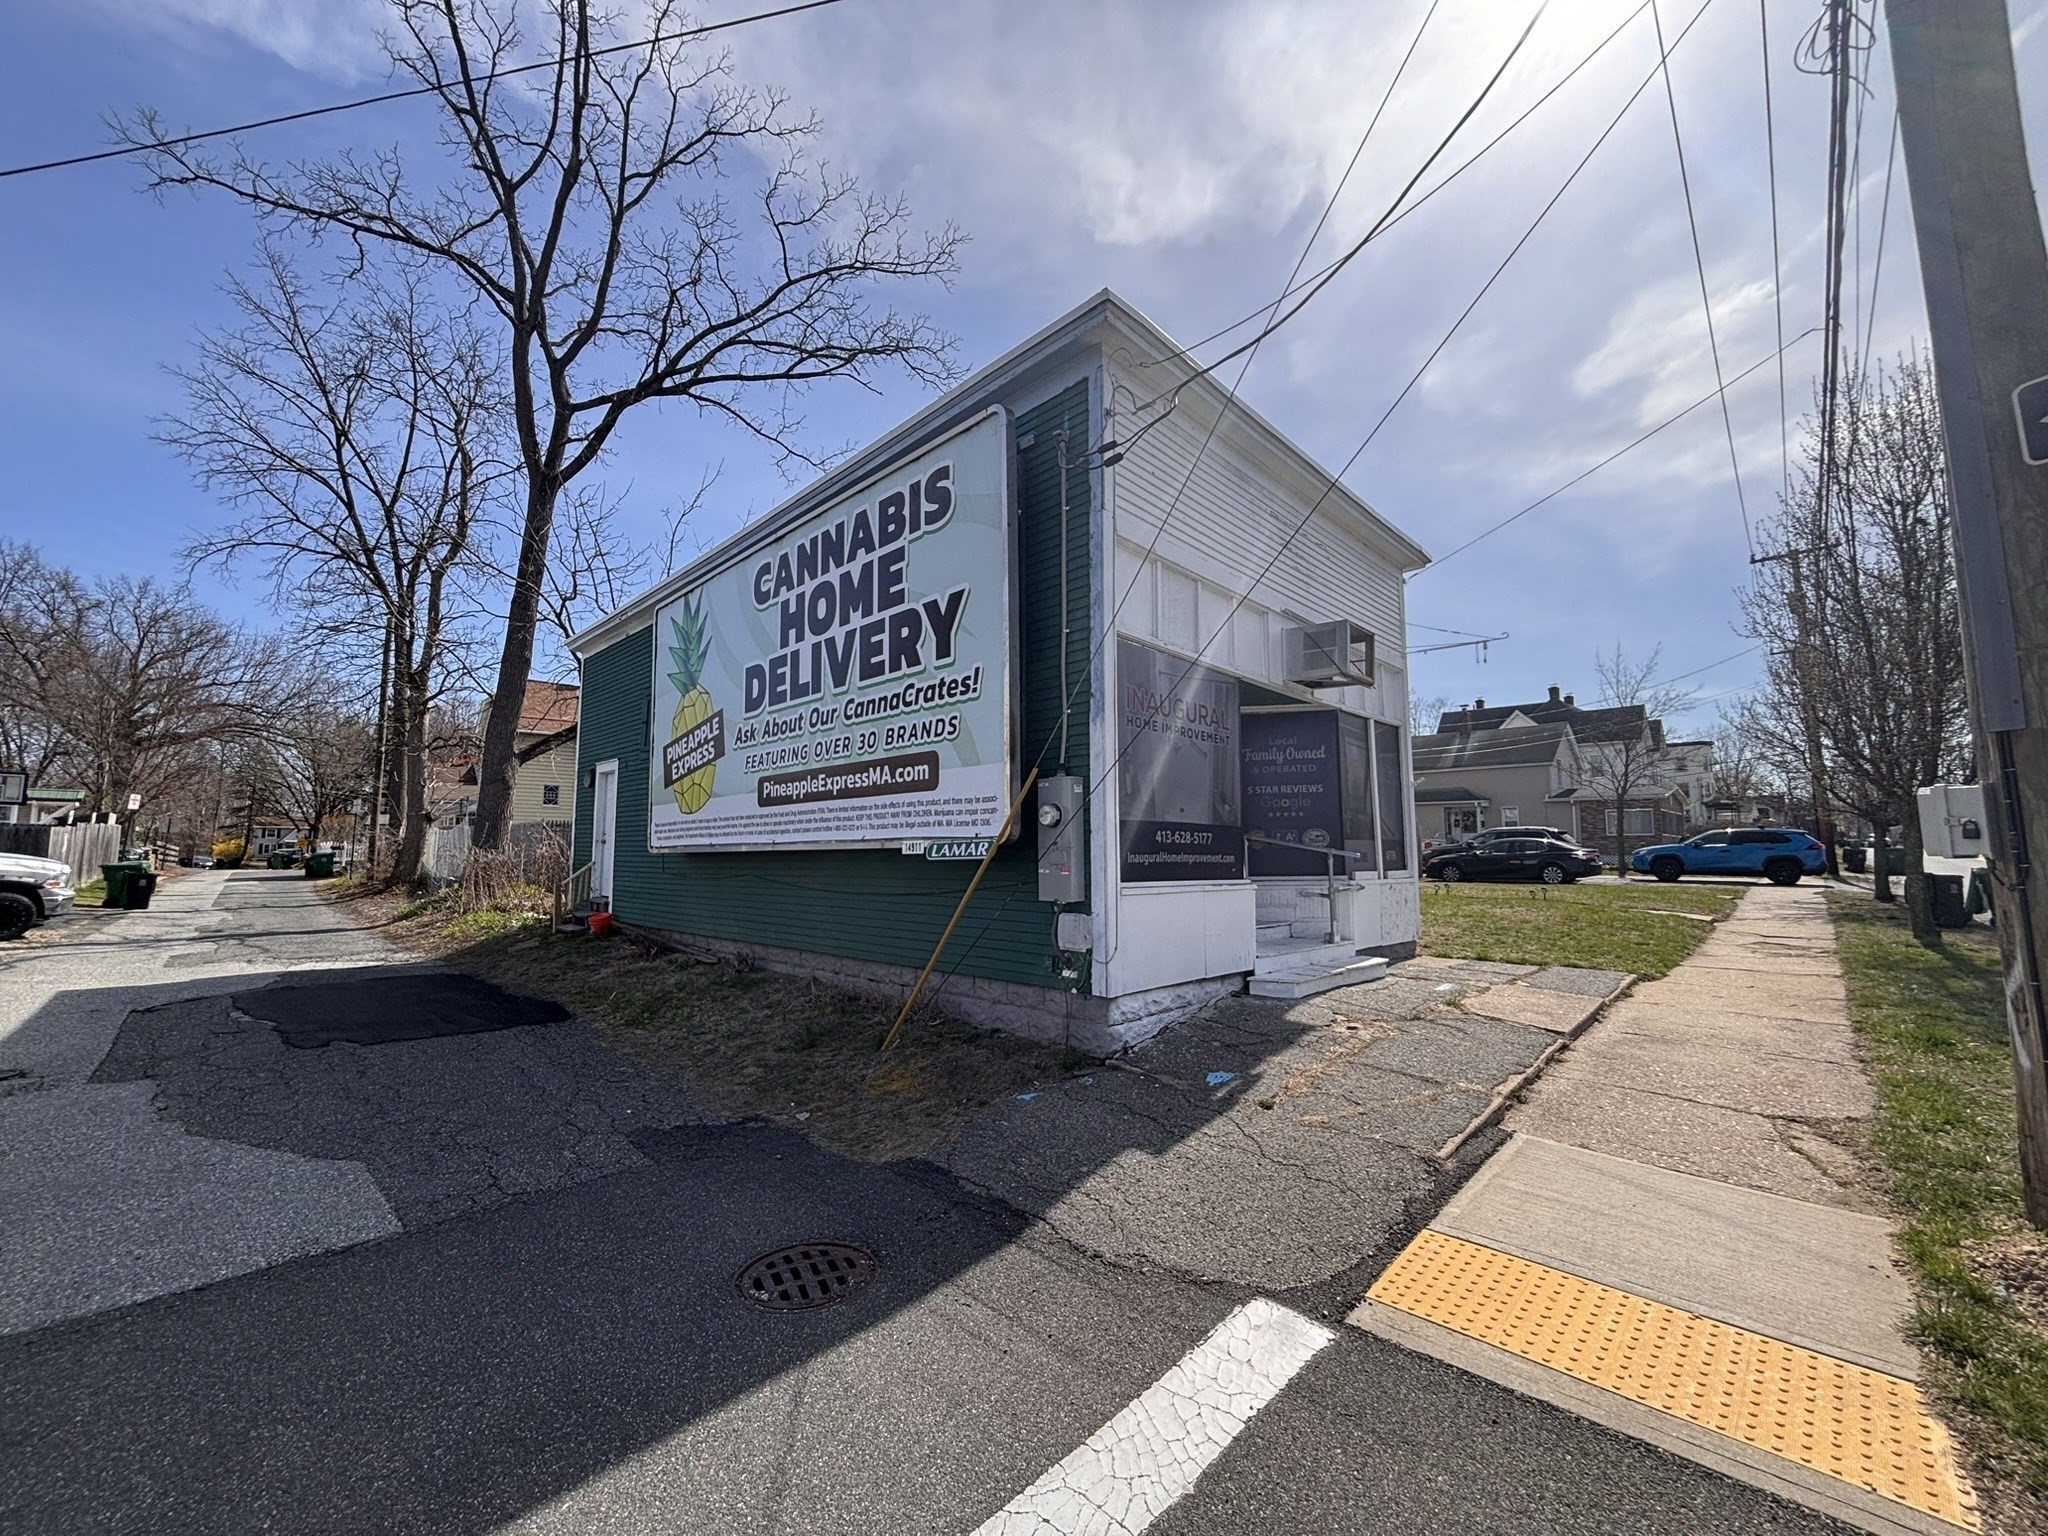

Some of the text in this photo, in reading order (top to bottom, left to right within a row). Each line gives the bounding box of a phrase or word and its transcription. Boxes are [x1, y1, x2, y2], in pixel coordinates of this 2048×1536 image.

[753, 464, 953, 605] CANNABIS
[779, 544, 906, 651] HOME
[744, 588, 966, 714] DELIVERY
[735, 667, 980, 746] Ask About Our CannaCrates!
[1126, 685, 1230, 731] INAUGURAL
[666, 716, 720, 765] PINEAPPLE
[744, 715, 959, 769] FEATURING OVER 30 BRANDS
[1126, 714, 1230, 746] HOME IMPROVEMENT
[1269, 736, 1297, 746] Local
[671, 740, 715, 780] EXPRESS
[1242, 745, 1326, 764] Family Owned
[1262, 764, 1317, 774] OPERATED
[762, 763, 929, 800] PineappleExpressMA.com
[1255, 785, 1279, 794] STAR
[1280, 784, 1324, 794] REVIEWS
[1260, 795, 1312, 810] Google
[904, 842, 922, 853] 14911
[931, 841, 988, 857] LAMAR
[1155, 830, 1213, 845] 413-628-5177
[1127, 851, 1235, 865] InauguralHomeImprovement.com
